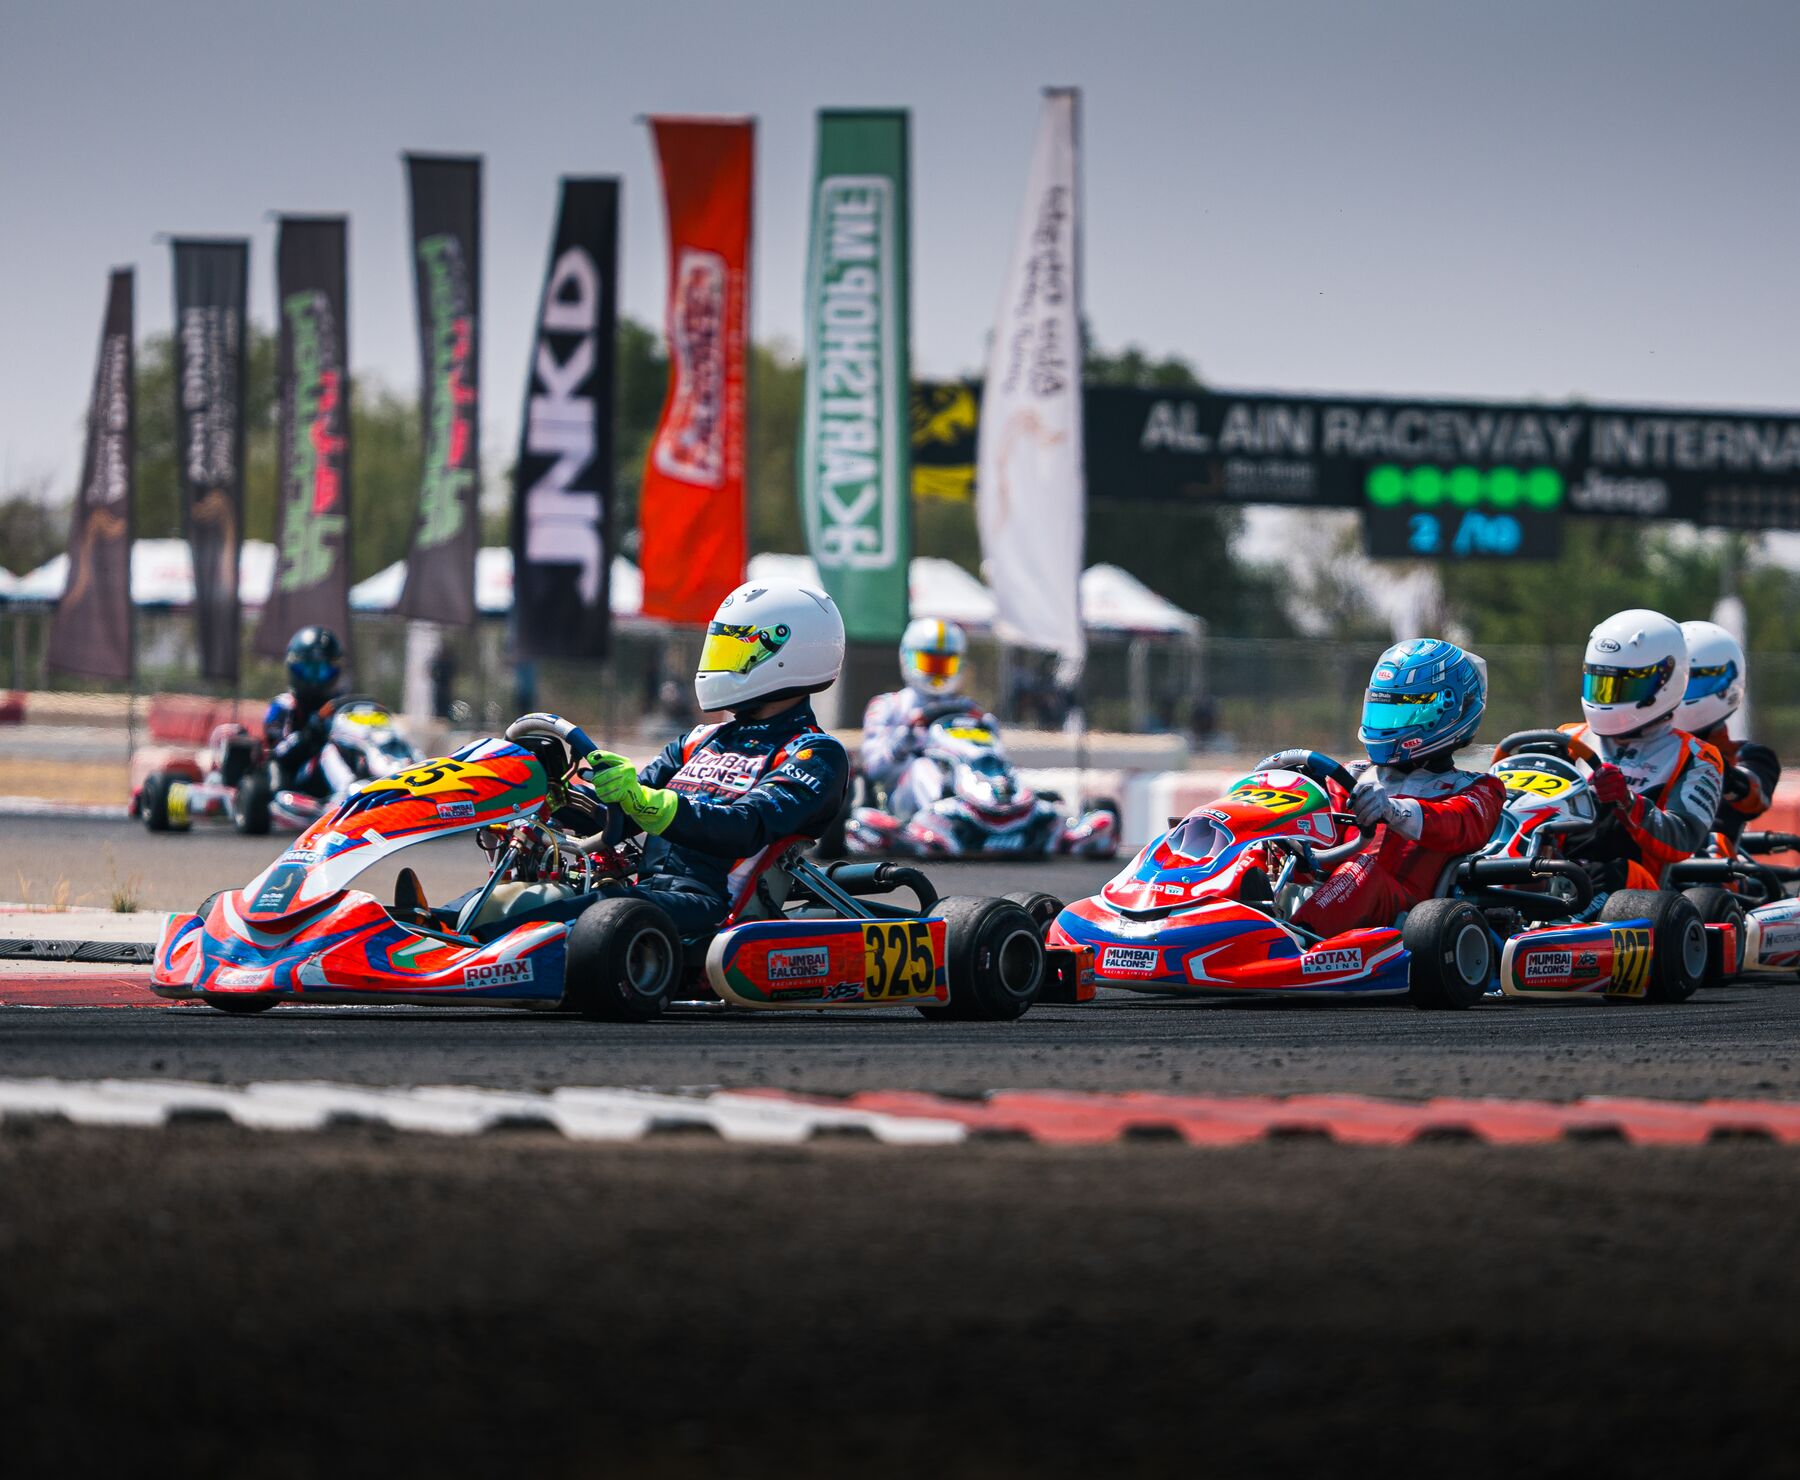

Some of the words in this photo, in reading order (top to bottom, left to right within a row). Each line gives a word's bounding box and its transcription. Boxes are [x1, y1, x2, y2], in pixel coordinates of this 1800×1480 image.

[525, 246, 601, 608] JNKD
[1141, 401, 1209, 450] AL
[1219, 404, 1314, 455] AIN
[1321, 408, 1582, 463] RACEWAY
[1378, 671, 1391, 679] BELL
[1403, 739, 1420, 748] BELL
[680, 766, 739, 784] ALCONS
[1316, 871, 1355, 908] INTERNATIONAL
[770, 953, 826, 968] MUMBAI
[865, 923, 934, 997] 325
[1107, 948, 1154, 961] MUMBAI
[1303, 950, 1358, 966] ROTAX
[1528, 954, 1570, 965] MUMBAI
[1609, 930, 1650, 993] 327
[466, 960, 529, 980] ROTAX
[1105, 958, 1146, 969] FALCONS
[1304, 962, 1360, 973] RACING
[1527, 963, 1564, 975] FALCONS
[771, 965, 819, 978] FALCONS
[467, 974, 530, 987] RACING
